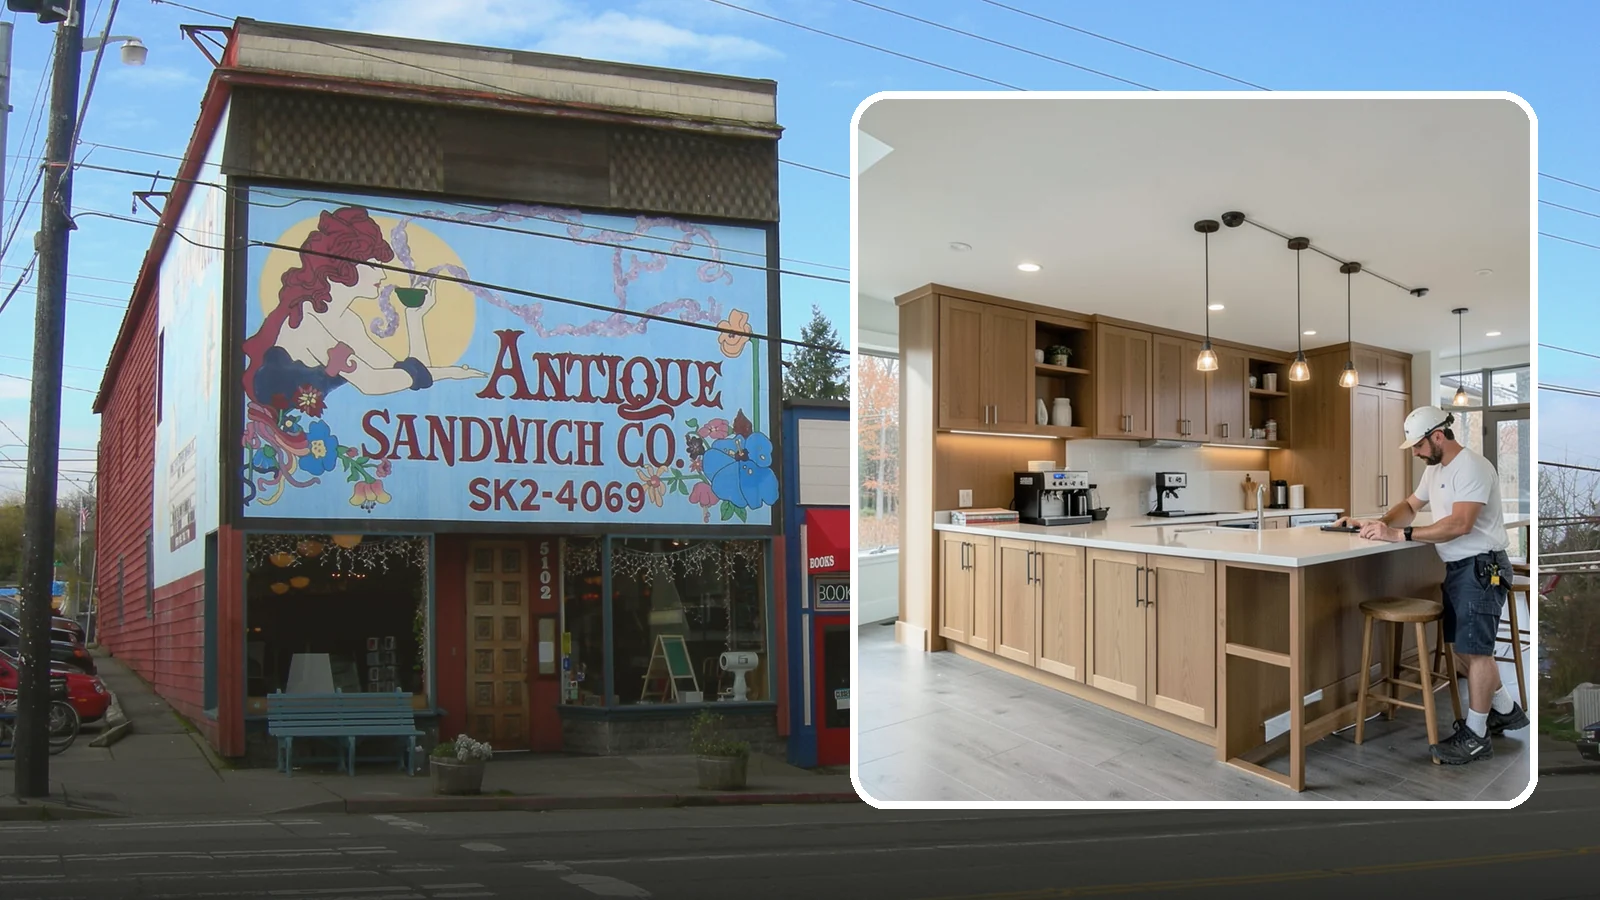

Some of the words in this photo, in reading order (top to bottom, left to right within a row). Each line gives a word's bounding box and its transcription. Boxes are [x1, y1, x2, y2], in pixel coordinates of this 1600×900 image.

[476, 329, 723, 420] ANTIQUE
[361, 408, 604, 467] SANDWICH
[617, 421, 684, 469] CO.
[468, 477, 646, 514] SK2-4069
[540, 541, 552, 600] 5102
[809, 555, 834, 569] BOOKS
